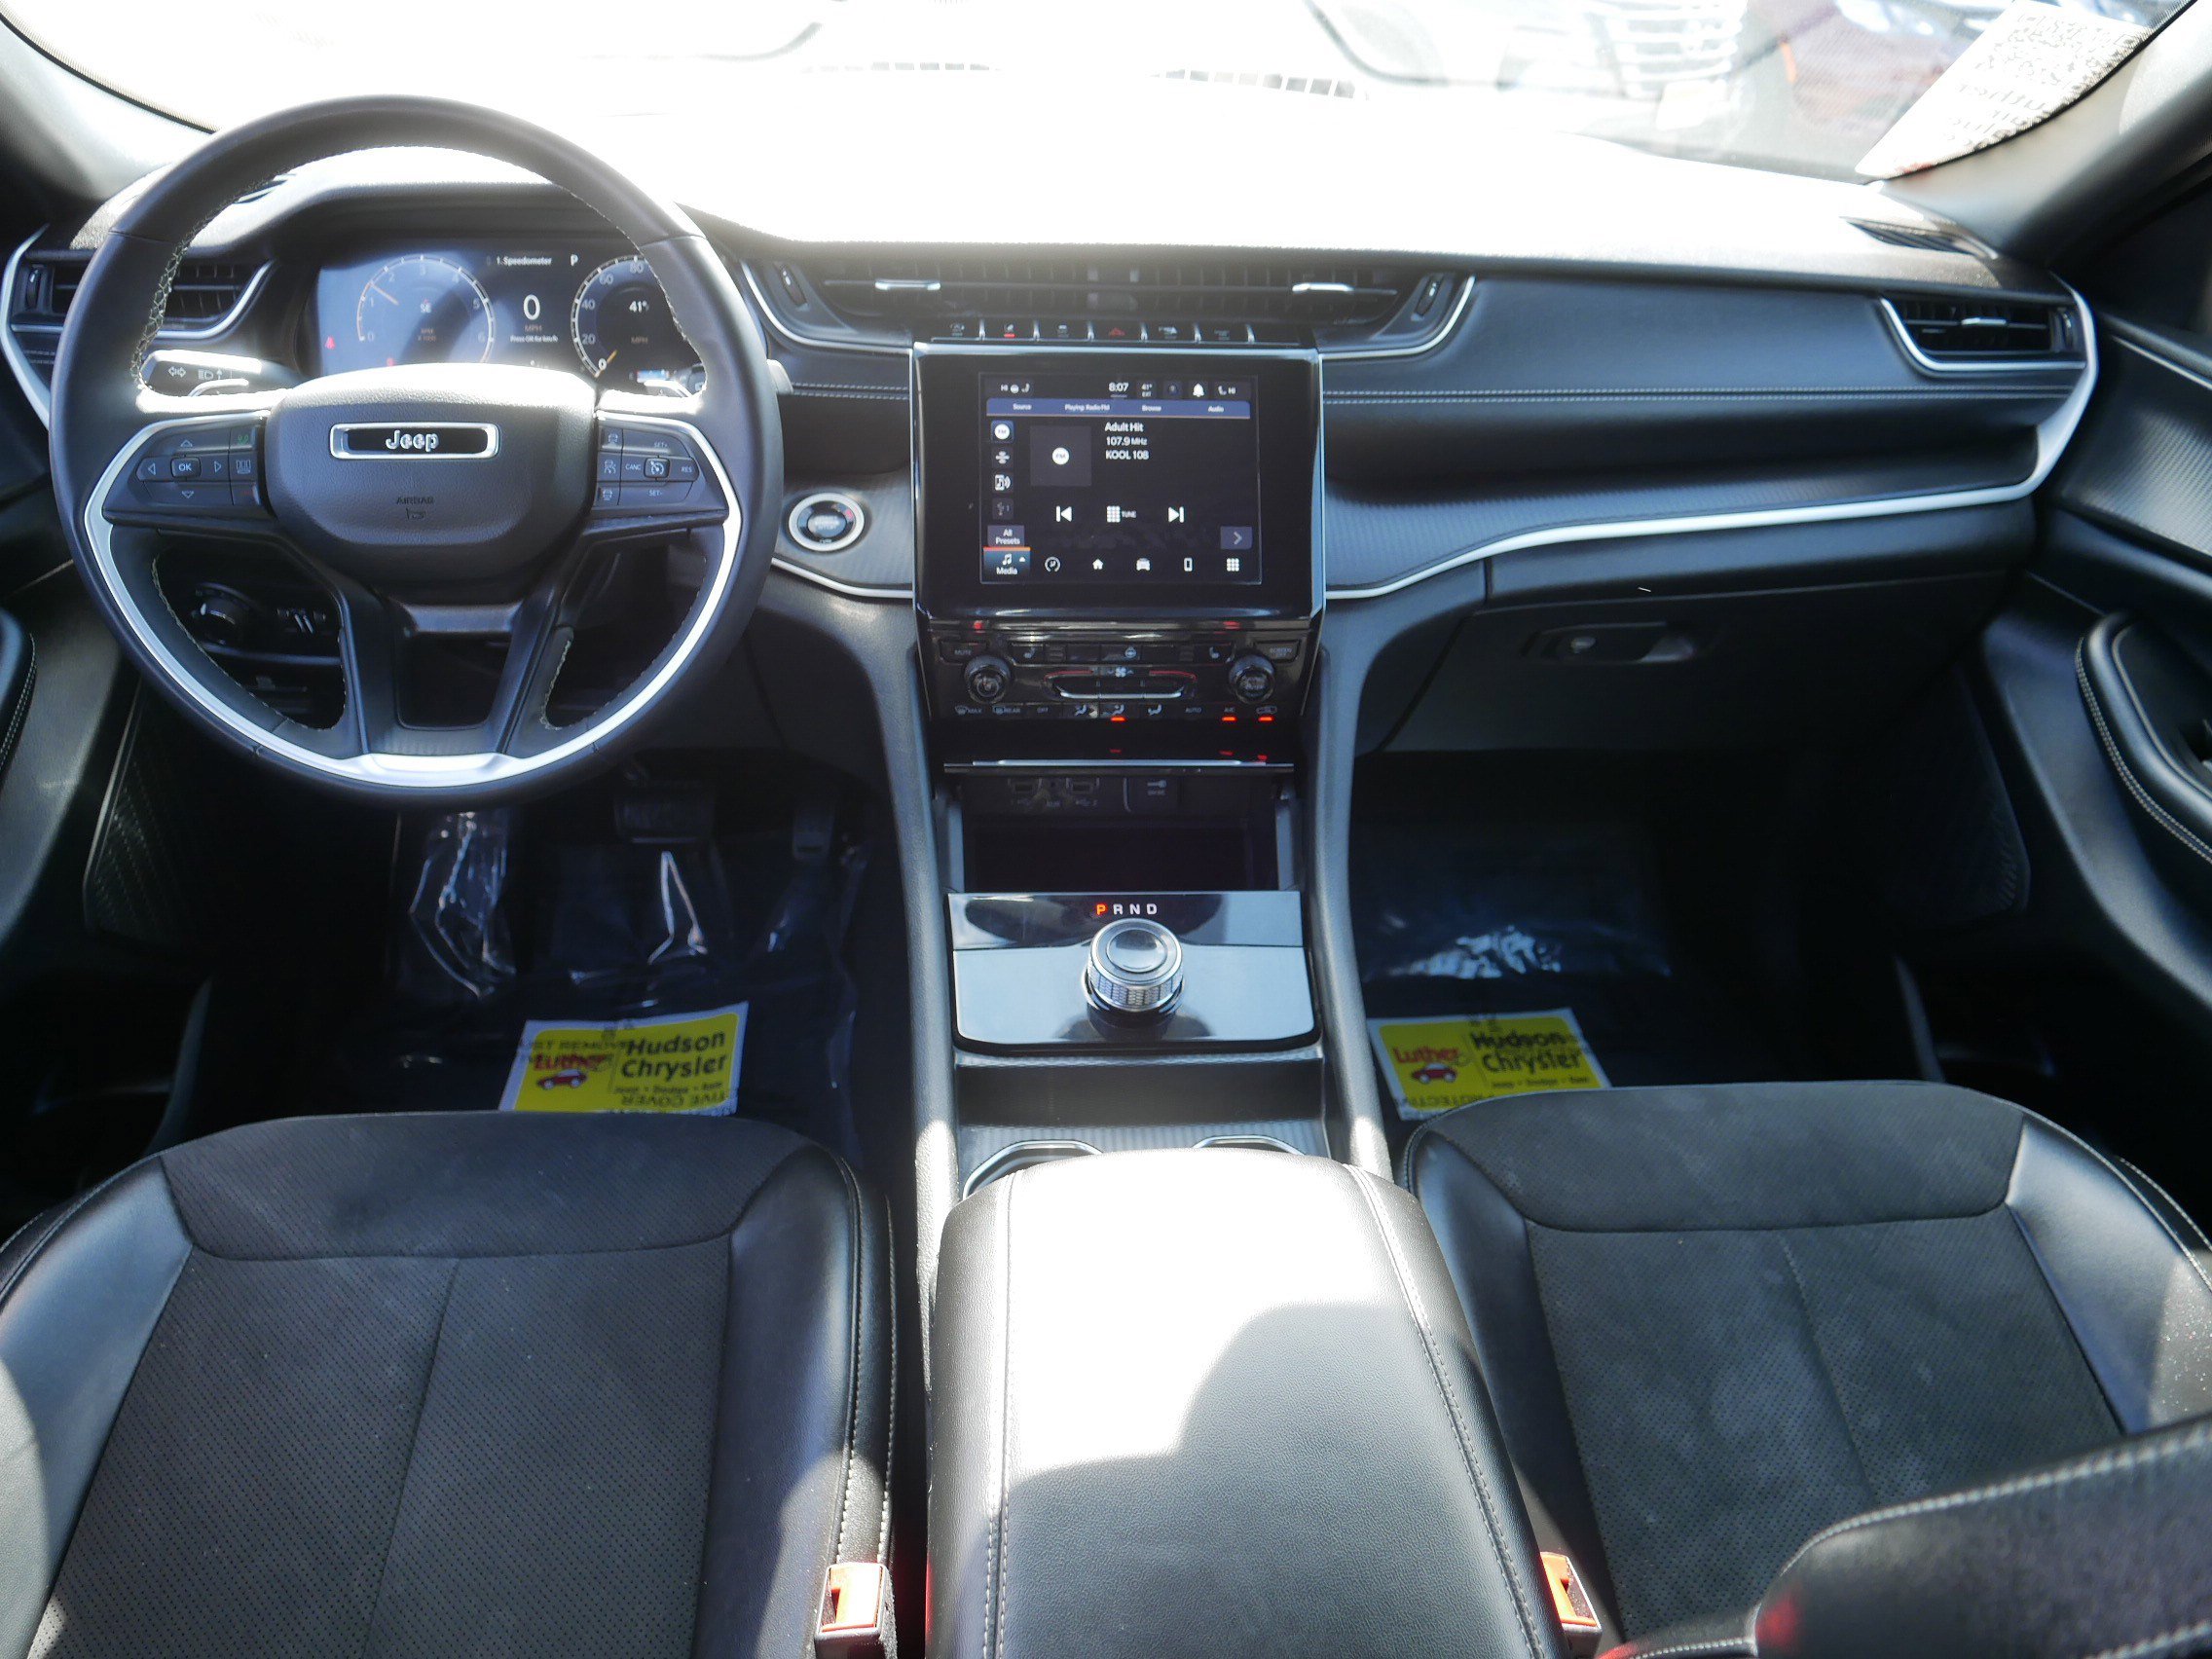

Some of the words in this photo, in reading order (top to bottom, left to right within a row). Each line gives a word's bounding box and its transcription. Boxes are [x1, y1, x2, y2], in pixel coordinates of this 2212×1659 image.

[570, 254, 579, 267] P
[599, 274, 614, 285] 60
[472, 297, 481, 310] 5
[523, 294, 541, 321] 0
[581, 333, 597, 346] 20
[598, 357, 608, 370] 0
[1108, 382, 1129, 393] 8:07
[1104, 421, 1129, 432] Adult
[1129, 422, 1145, 432] Hit
[385, 429, 440, 453] Jeep
[1106, 435, 1131, 447] 107.9
[1130, 436, 1148, 446] MHz
[1105, 449, 1131, 461] KOOL
[178, 462, 193, 472] OK
[1002, 528, 1014, 536] All
[995, 536, 1021, 545] Presets
[996, 567, 1018, 576] Media
[1096, 903, 1108, 915] P
[1113, 903, 1124, 915] R
[1129, 903, 1141, 915] N
[1146, 903, 1158, 915] D
[625, 1030, 726, 1056] Hudson
[1393, 1046, 1459, 1064] Luther
[1481, 1049, 1583, 1075] Chrysler
[622, 1054, 728, 1083] Chrysler
